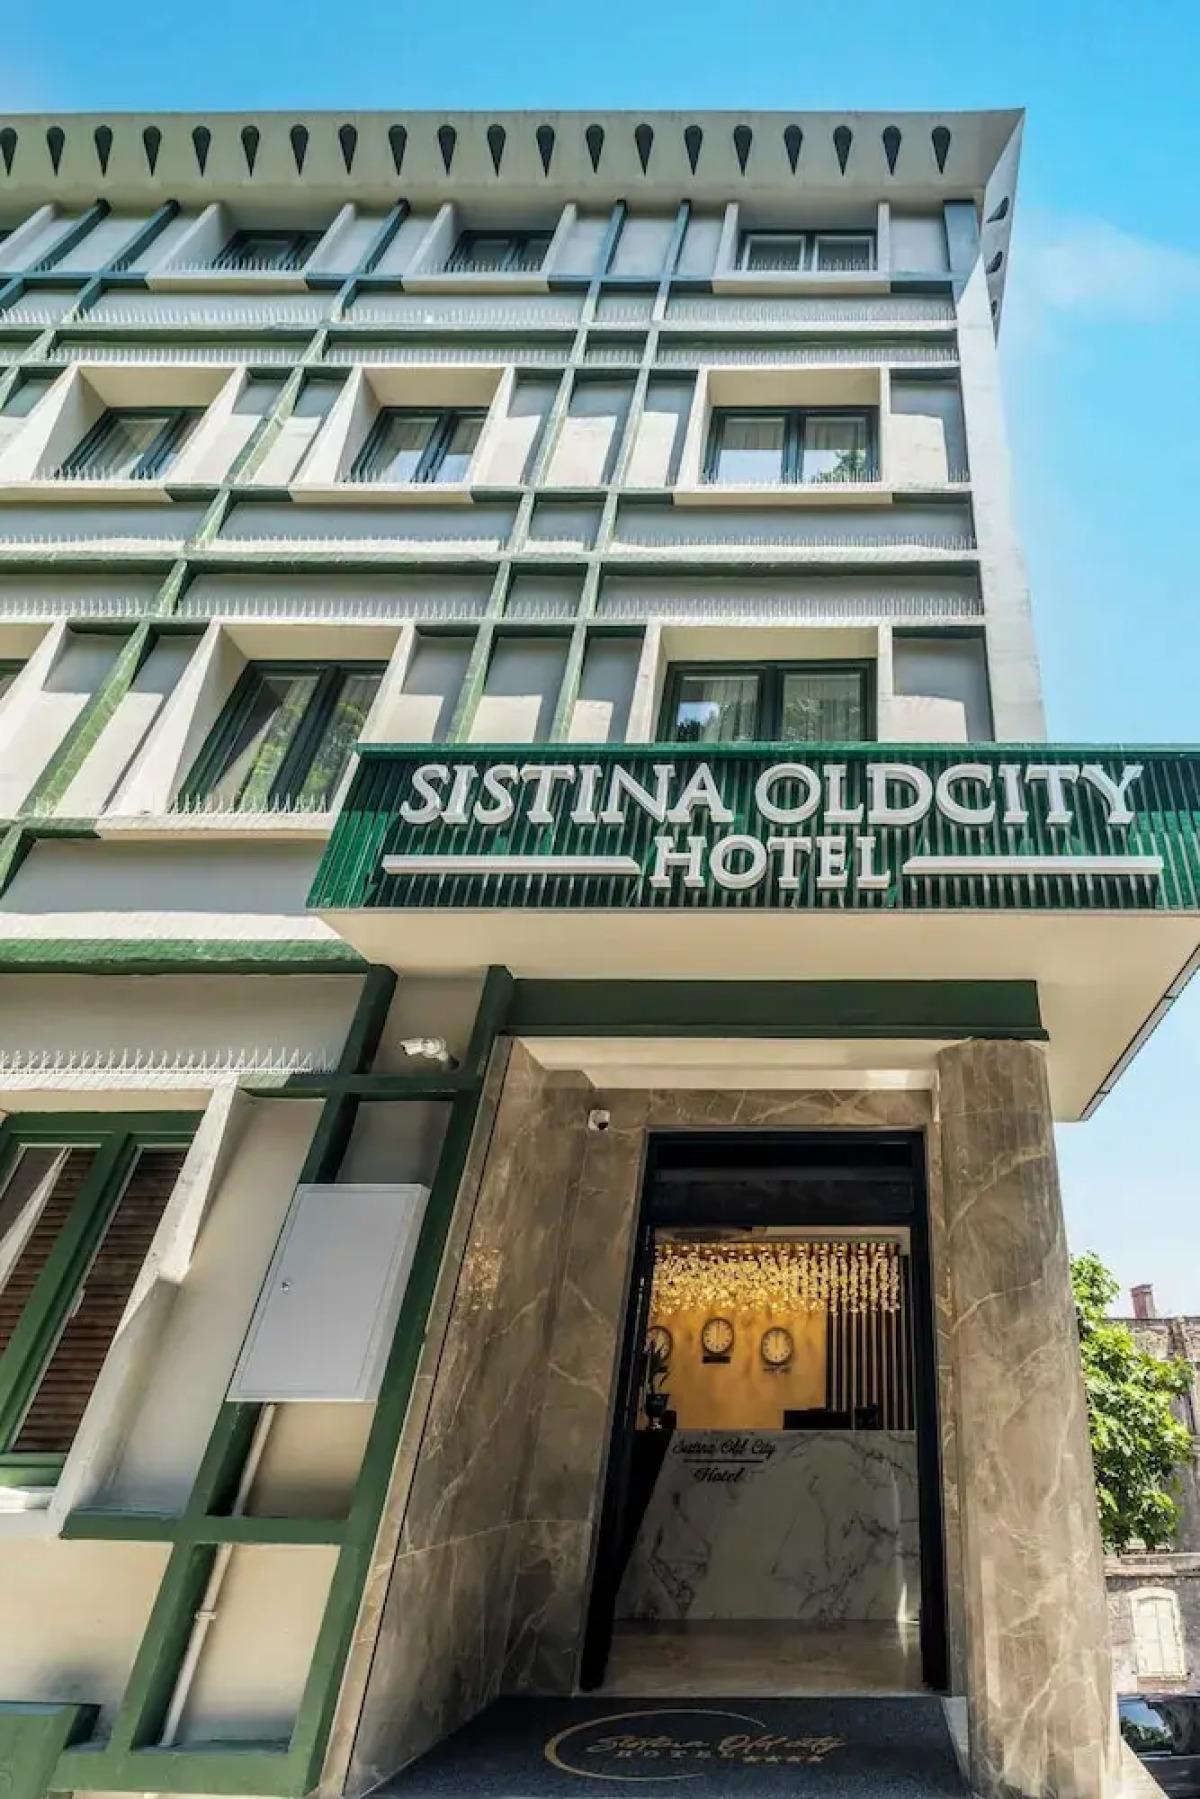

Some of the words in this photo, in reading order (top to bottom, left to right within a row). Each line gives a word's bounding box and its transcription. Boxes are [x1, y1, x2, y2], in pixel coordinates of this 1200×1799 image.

[400, 763, 732, 825] SISTINA
[755, 763, 1142, 826] OLDCITY
[649, 835, 891, 890] HOTEL
[721, 1436, 749, 1455] Old
[751, 1438, 777, 1459] City
[692, 1467, 745, 1483] Hotel
